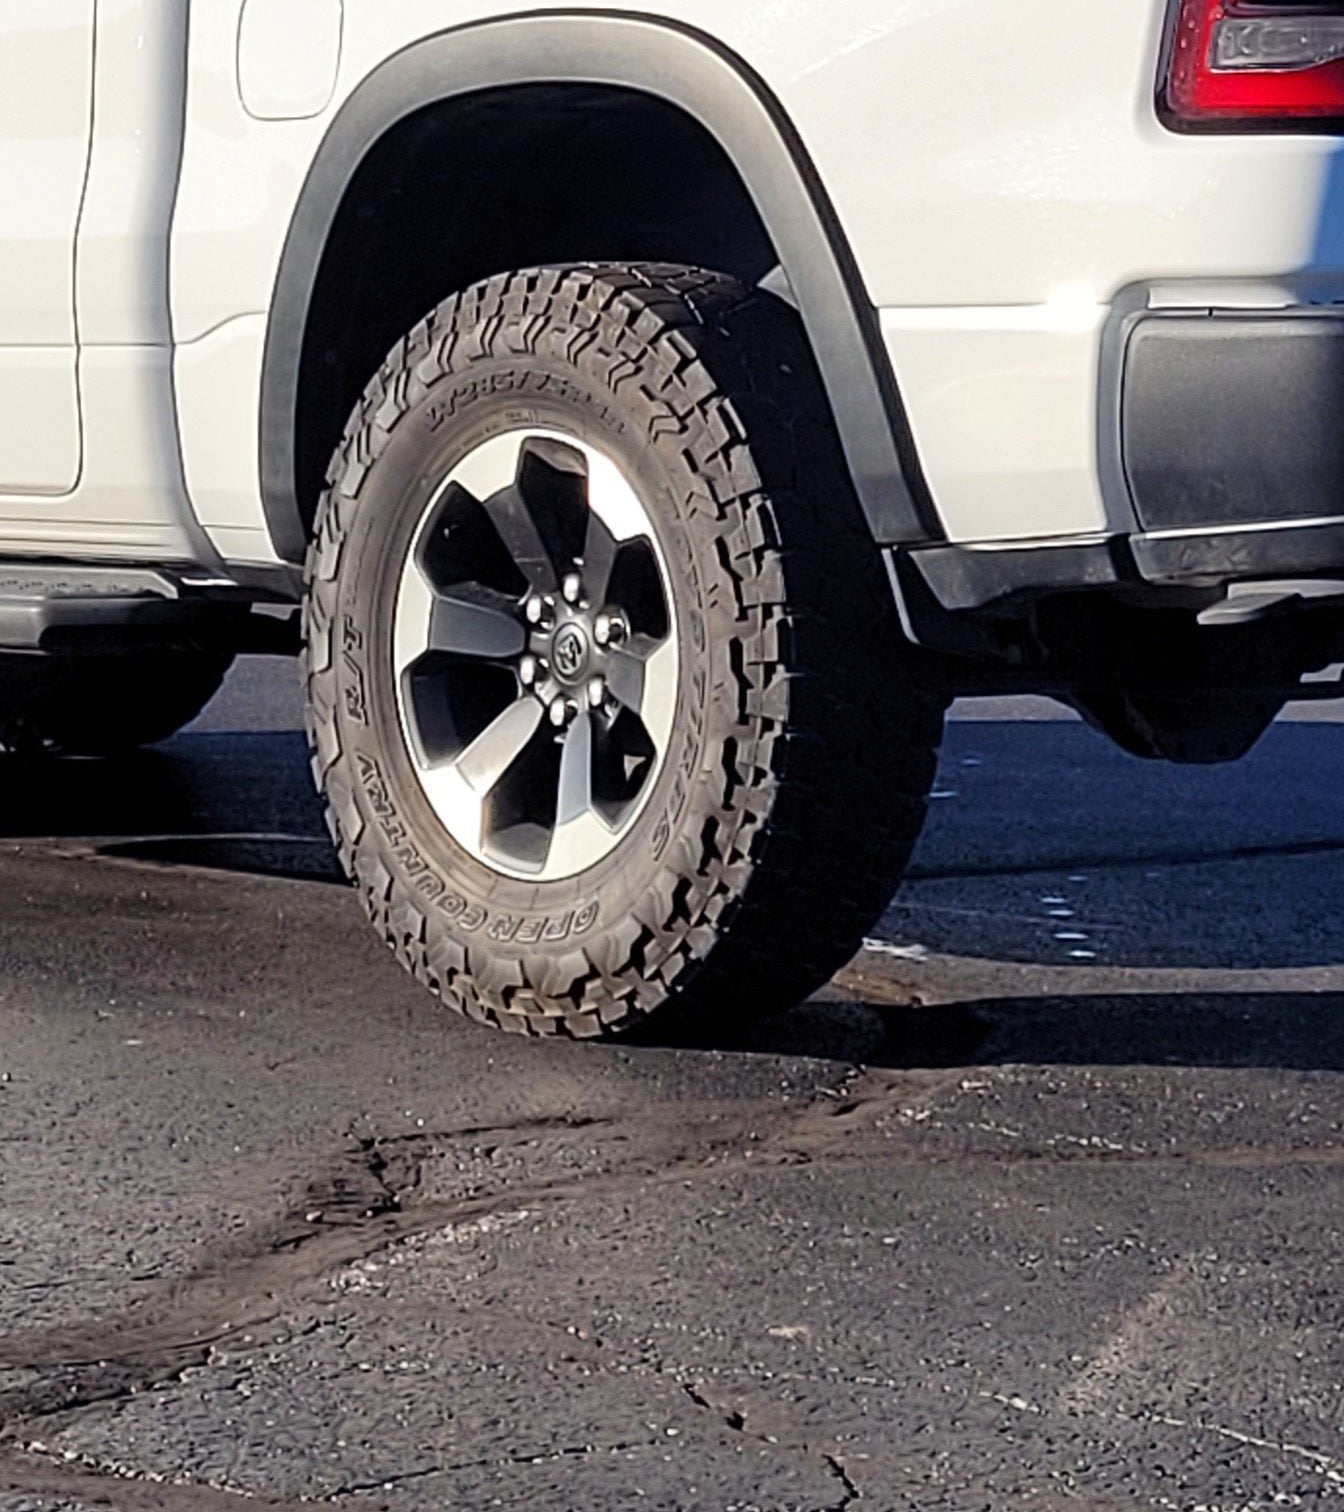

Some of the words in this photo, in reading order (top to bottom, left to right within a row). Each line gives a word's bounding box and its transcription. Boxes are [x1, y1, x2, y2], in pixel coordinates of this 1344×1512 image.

[340, 614, 369, 727] R/T
[357, 753, 489, 932] COUNTRY
[488, 898, 601, 944] OPEN
